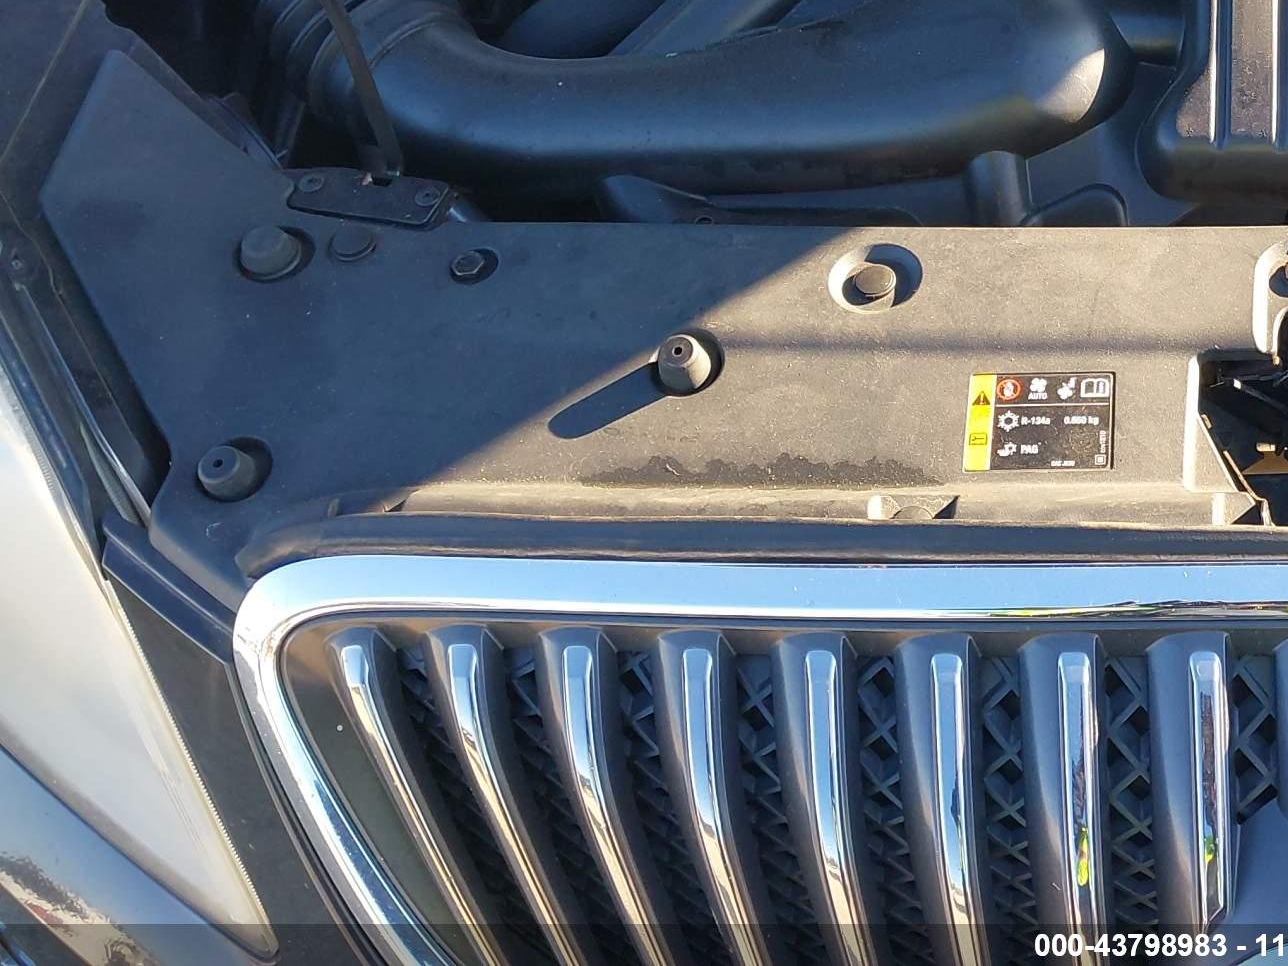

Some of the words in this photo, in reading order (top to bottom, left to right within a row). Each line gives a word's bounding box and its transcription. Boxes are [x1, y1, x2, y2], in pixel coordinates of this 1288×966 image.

[1028, 392, 1048, 400] AUTO
[1021, 416, 1051, 425] R-134a
[1088, 416, 1099, 426] kg
[1021, 444, 1038, 454] PAG
